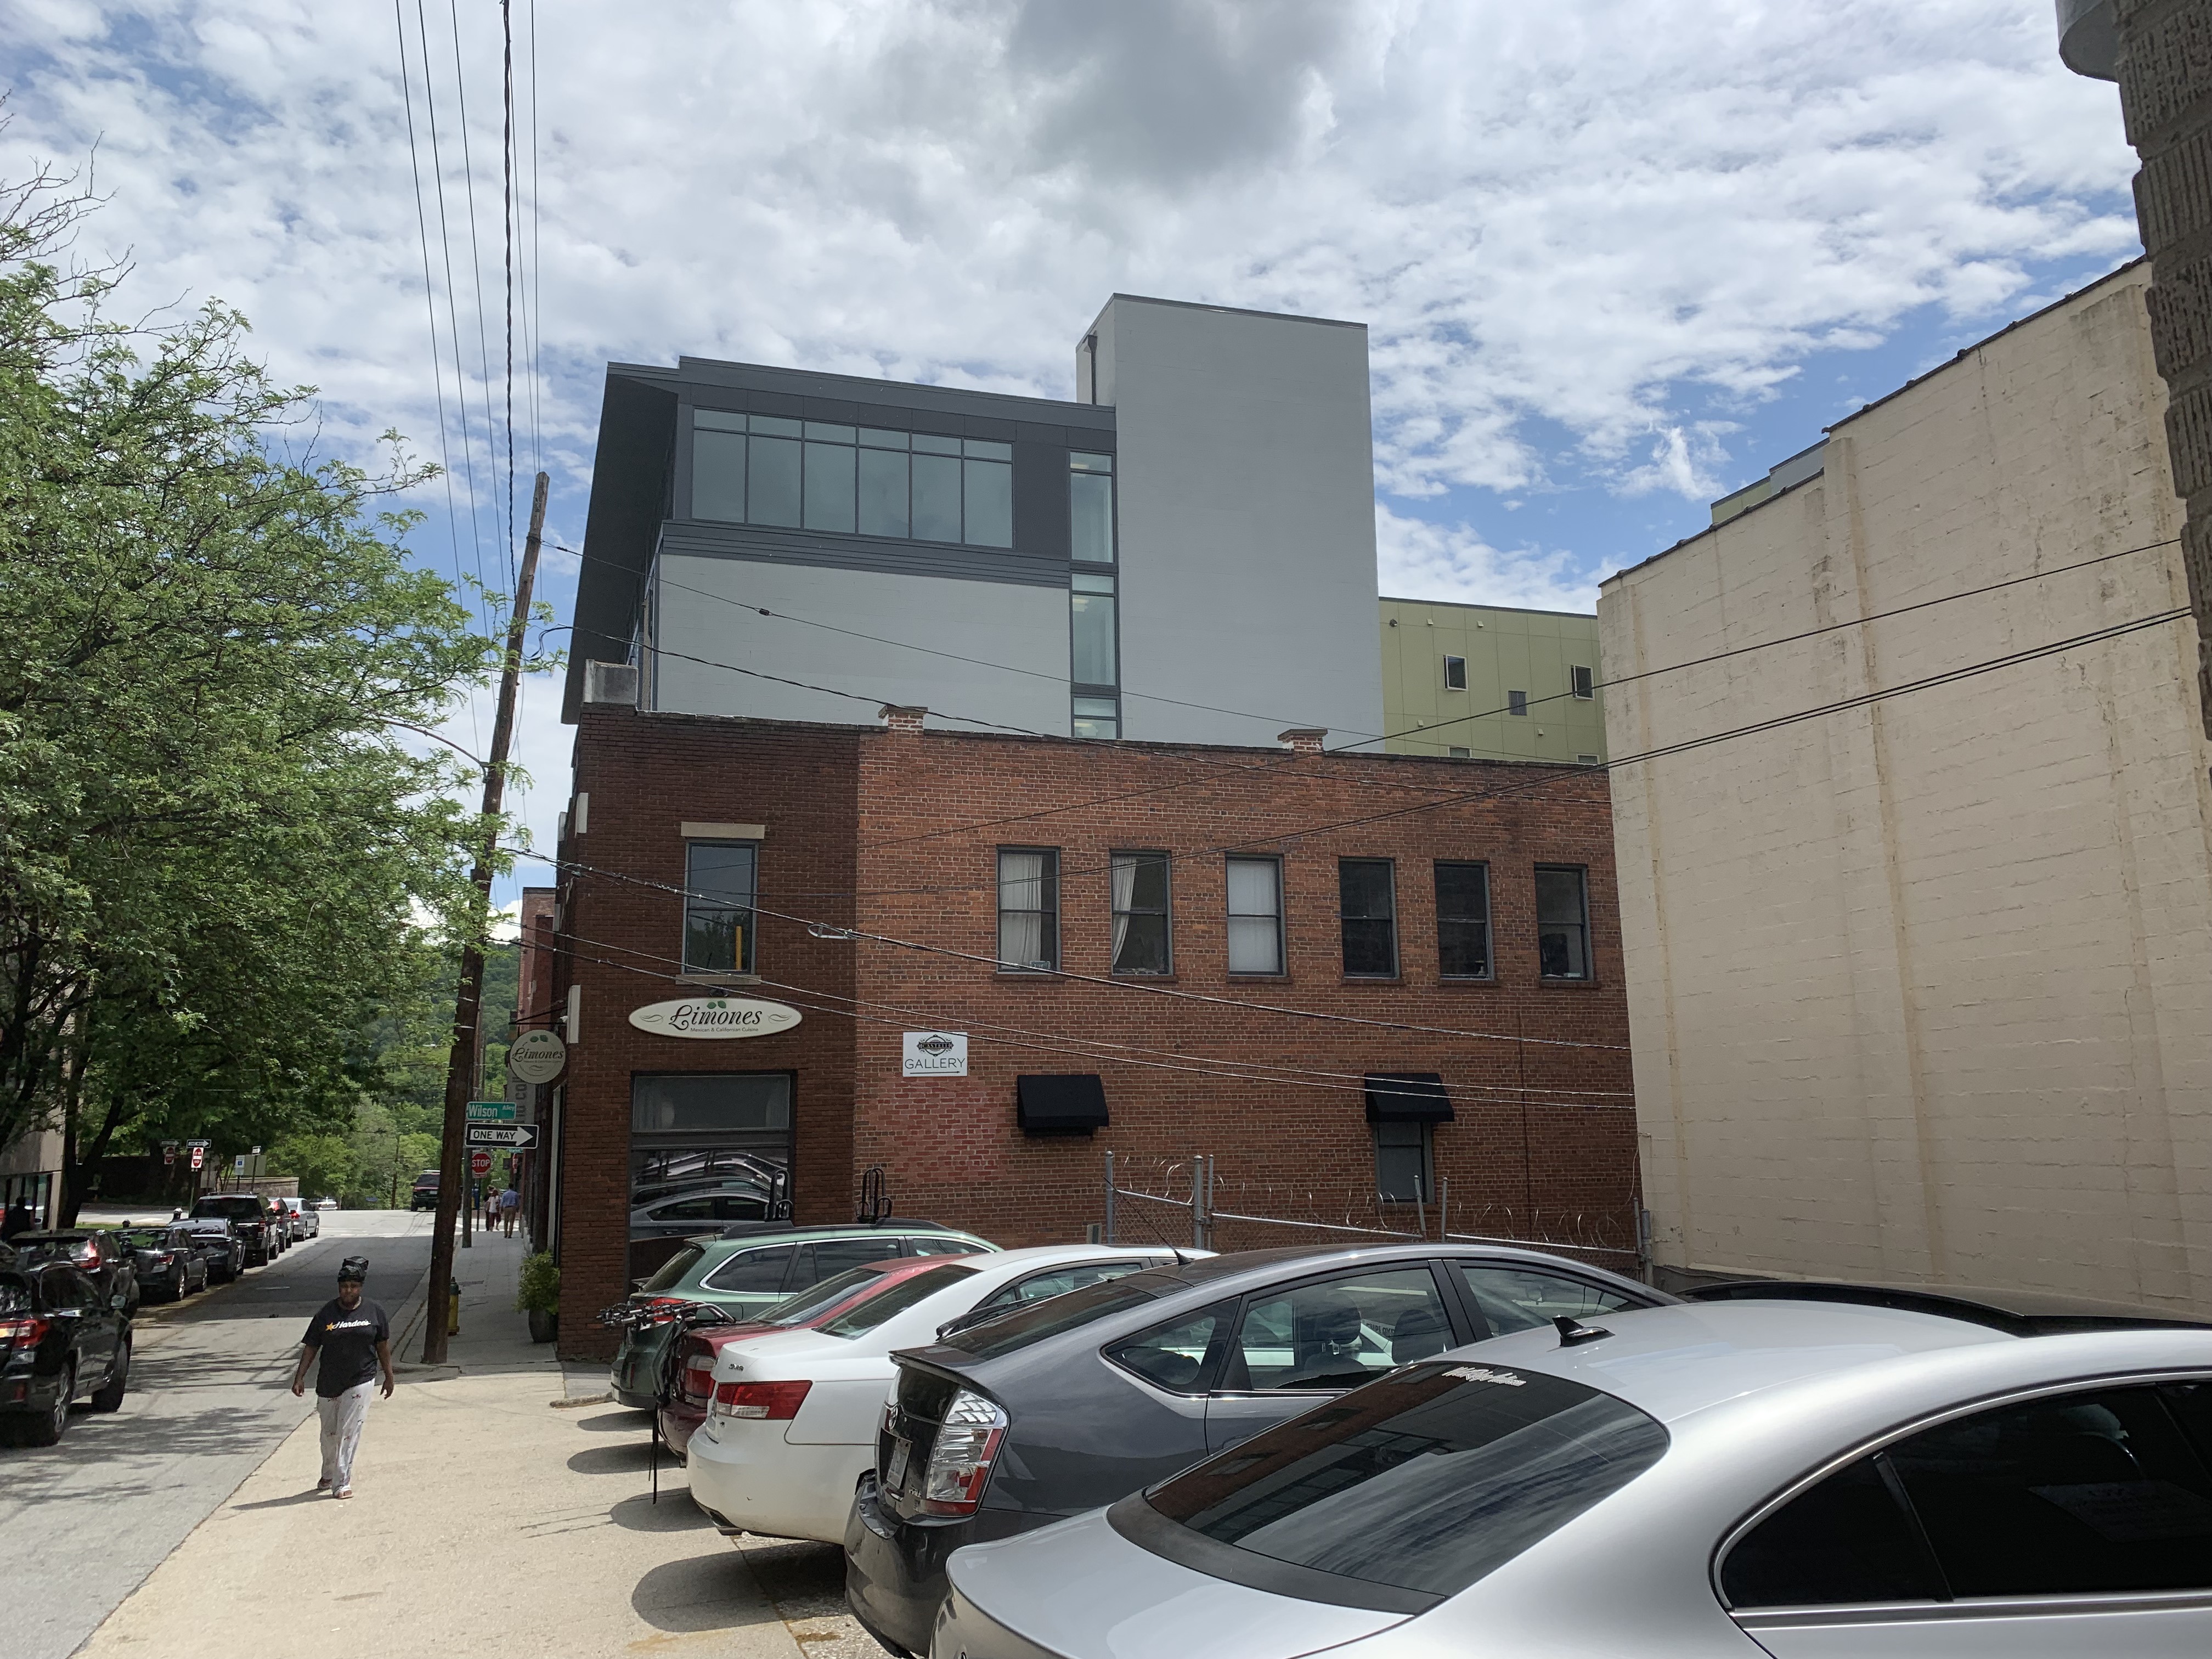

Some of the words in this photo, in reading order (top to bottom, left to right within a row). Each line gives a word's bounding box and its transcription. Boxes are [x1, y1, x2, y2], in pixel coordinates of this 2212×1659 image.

[668, 1005, 763, 1031] Limones
[511, 1047, 564, 1062] Limones
[905, 1058, 966, 1069] GALLERY
[469, 1104, 498, 1118] Wilson
[473, 1130, 493, 1139] ONE
[496, 1131, 516, 1140] WAY
[472, 1159, 490, 1167] STOP
[332, 1319, 371, 1329] Hardee's
